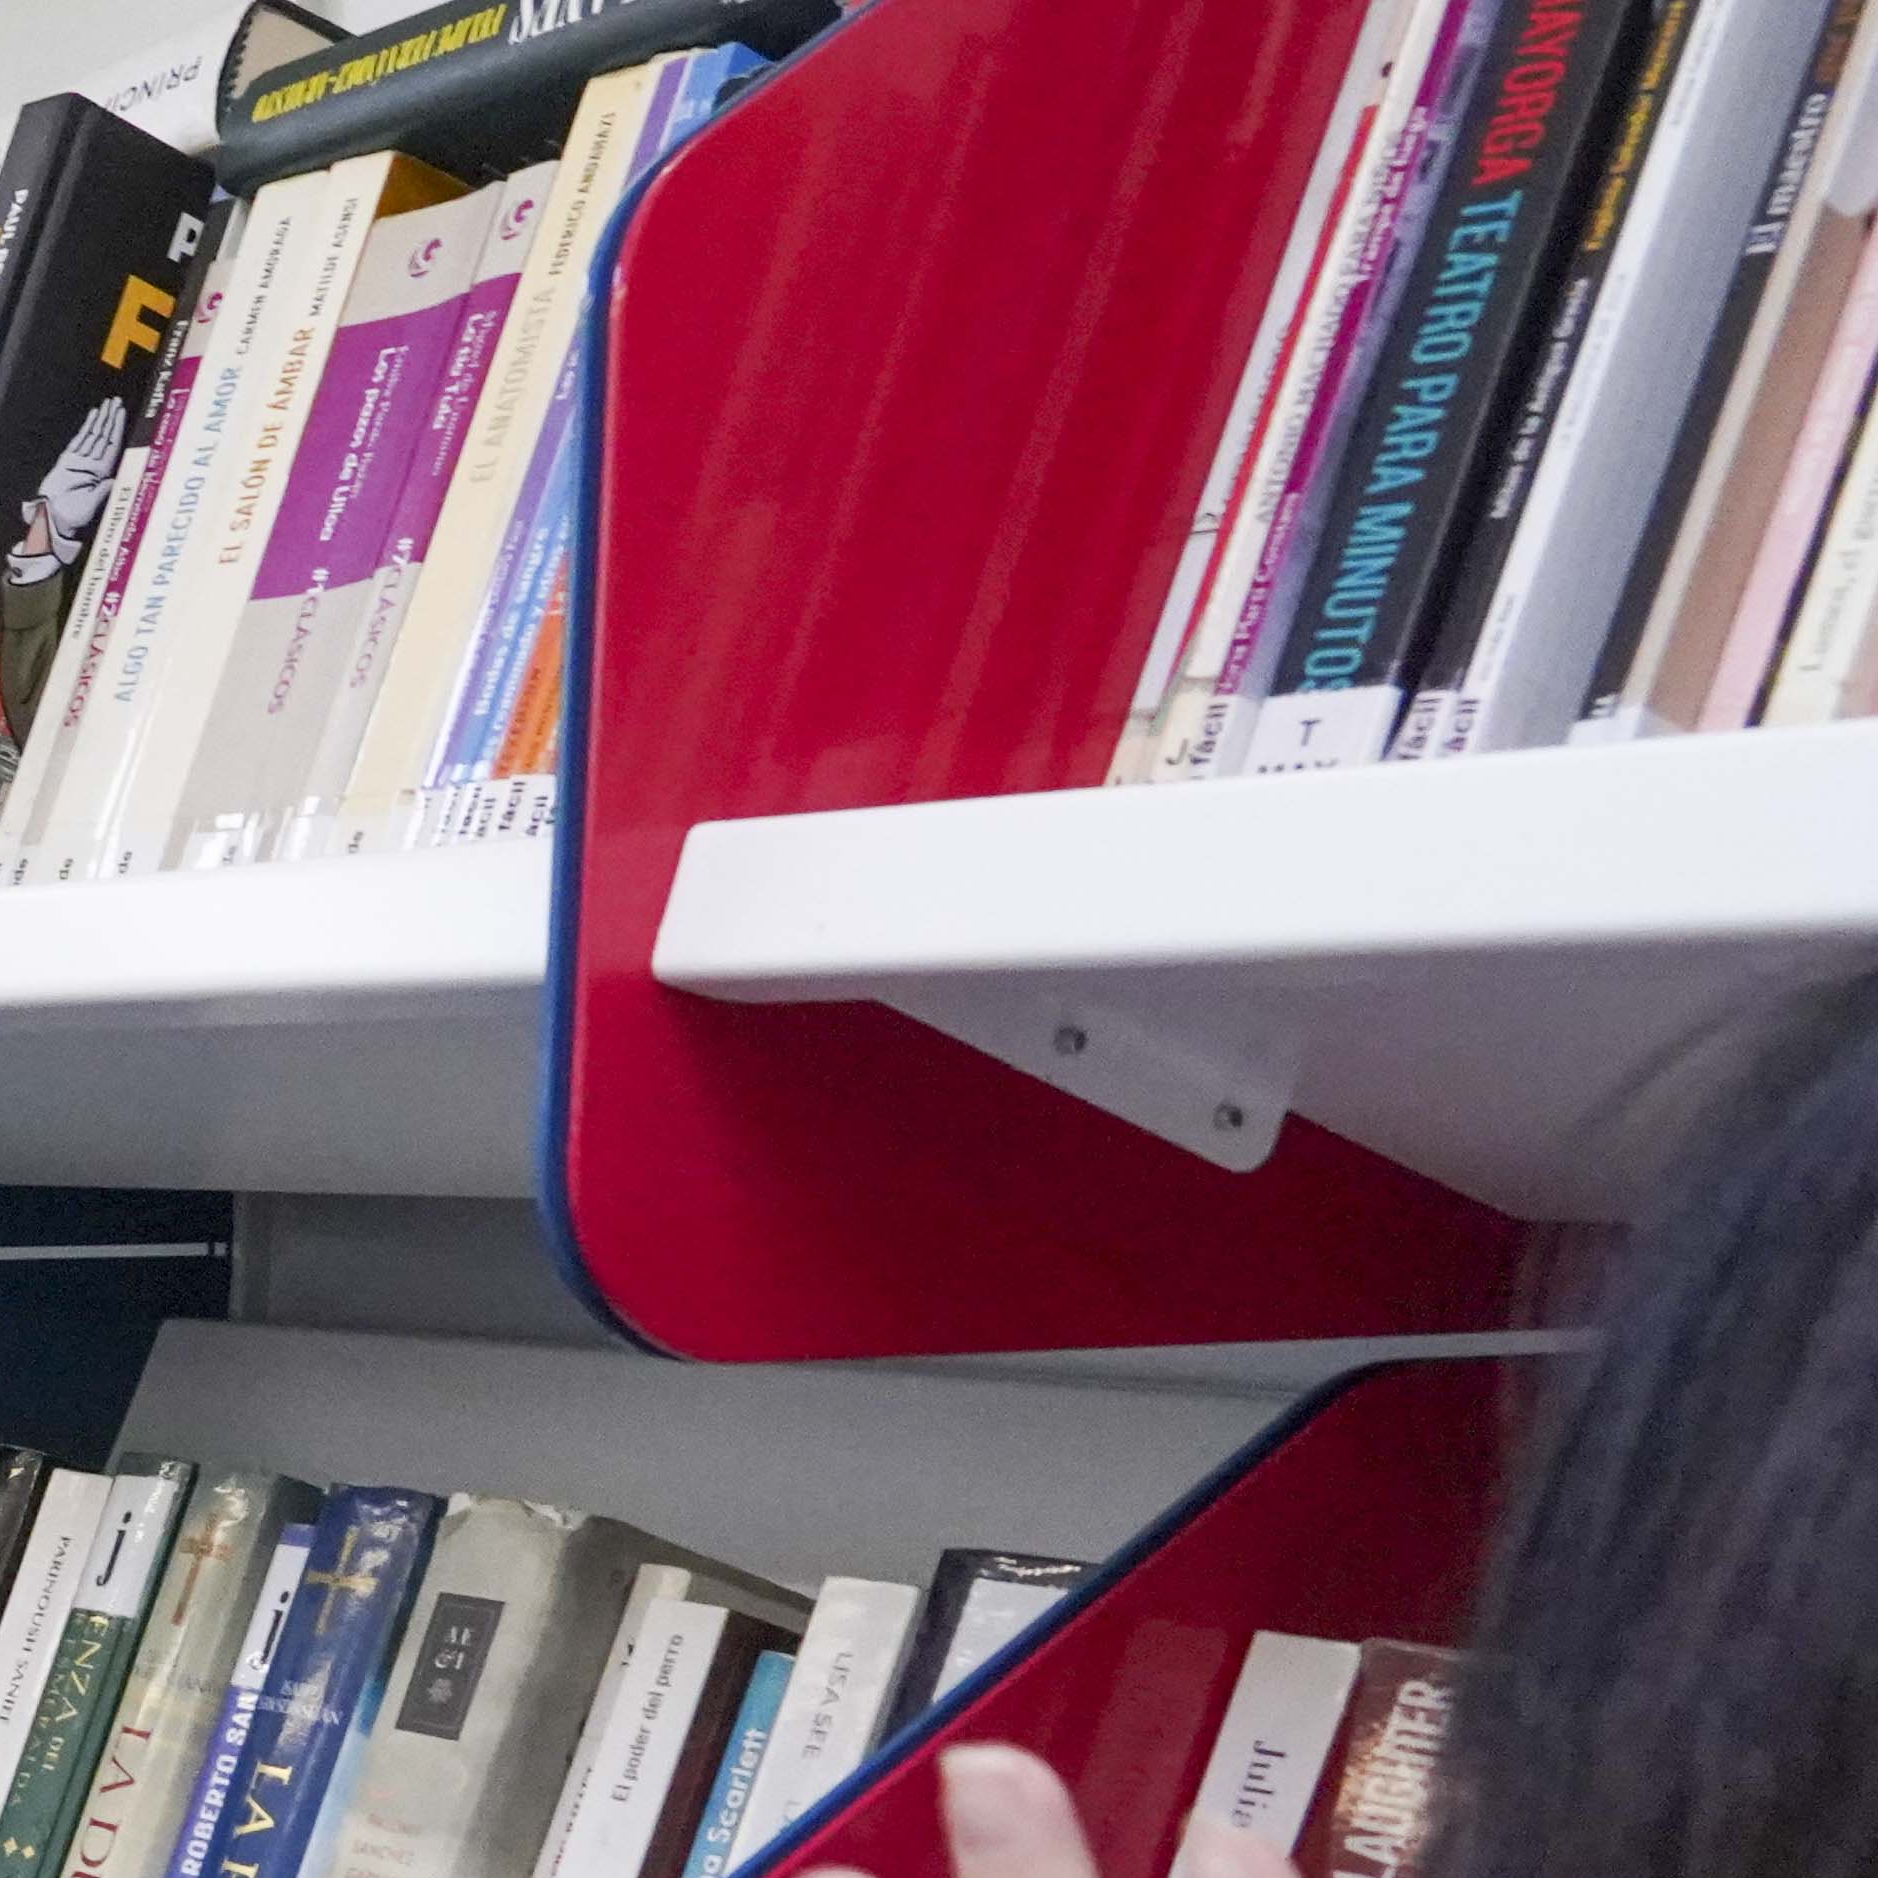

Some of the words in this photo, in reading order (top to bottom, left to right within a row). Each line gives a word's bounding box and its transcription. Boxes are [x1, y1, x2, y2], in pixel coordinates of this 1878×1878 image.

[1472, 0, 1583, 186] AYORGA
[1411, 189, 1524, 365] TEATRO
[157, 316, 194, 368] Franz
[264, 319, 320, 414] ÁMBAR
[481, 280, 560, 450] ANATOMISTA
[201, 363, 245, 436] AMOR
[254, 416, 286, 453] DE
[1366, 374, 1459, 496] PARA
[192, 434, 221, 471] AL
[223, 451, 275, 532] SALÓN
[311, 480, 355, 545] Ulloa
[149, 470, 211, 589] PARECIDO
[215, 536, 246, 570] EL
[133, 590, 168, 639] TAN
[110, 639, 154, 707] ALGO
[1300, 718, 1321, 747] T
[95, 1509, 134, 1589] j
[19, 1533, 71, 1655] PARINOUSH
[252, 1592, 289, 1668] j
[653, 1632, 687, 1690] perro
[814, 1648, 861, 1710] LISA
[639, 1688, 665, 1722] del
[795, 1708, 837, 1763] SEE
[98, 1718, 151, 1802] LA
[621, 1724, 655, 1783] poder
[703, 1723, 771, 1847] Scarlett
[180, 1751, 238, 1878] ROBERTO
[230, 1754, 293, 1846] LA
[614, 1783, 633, 1803] El
